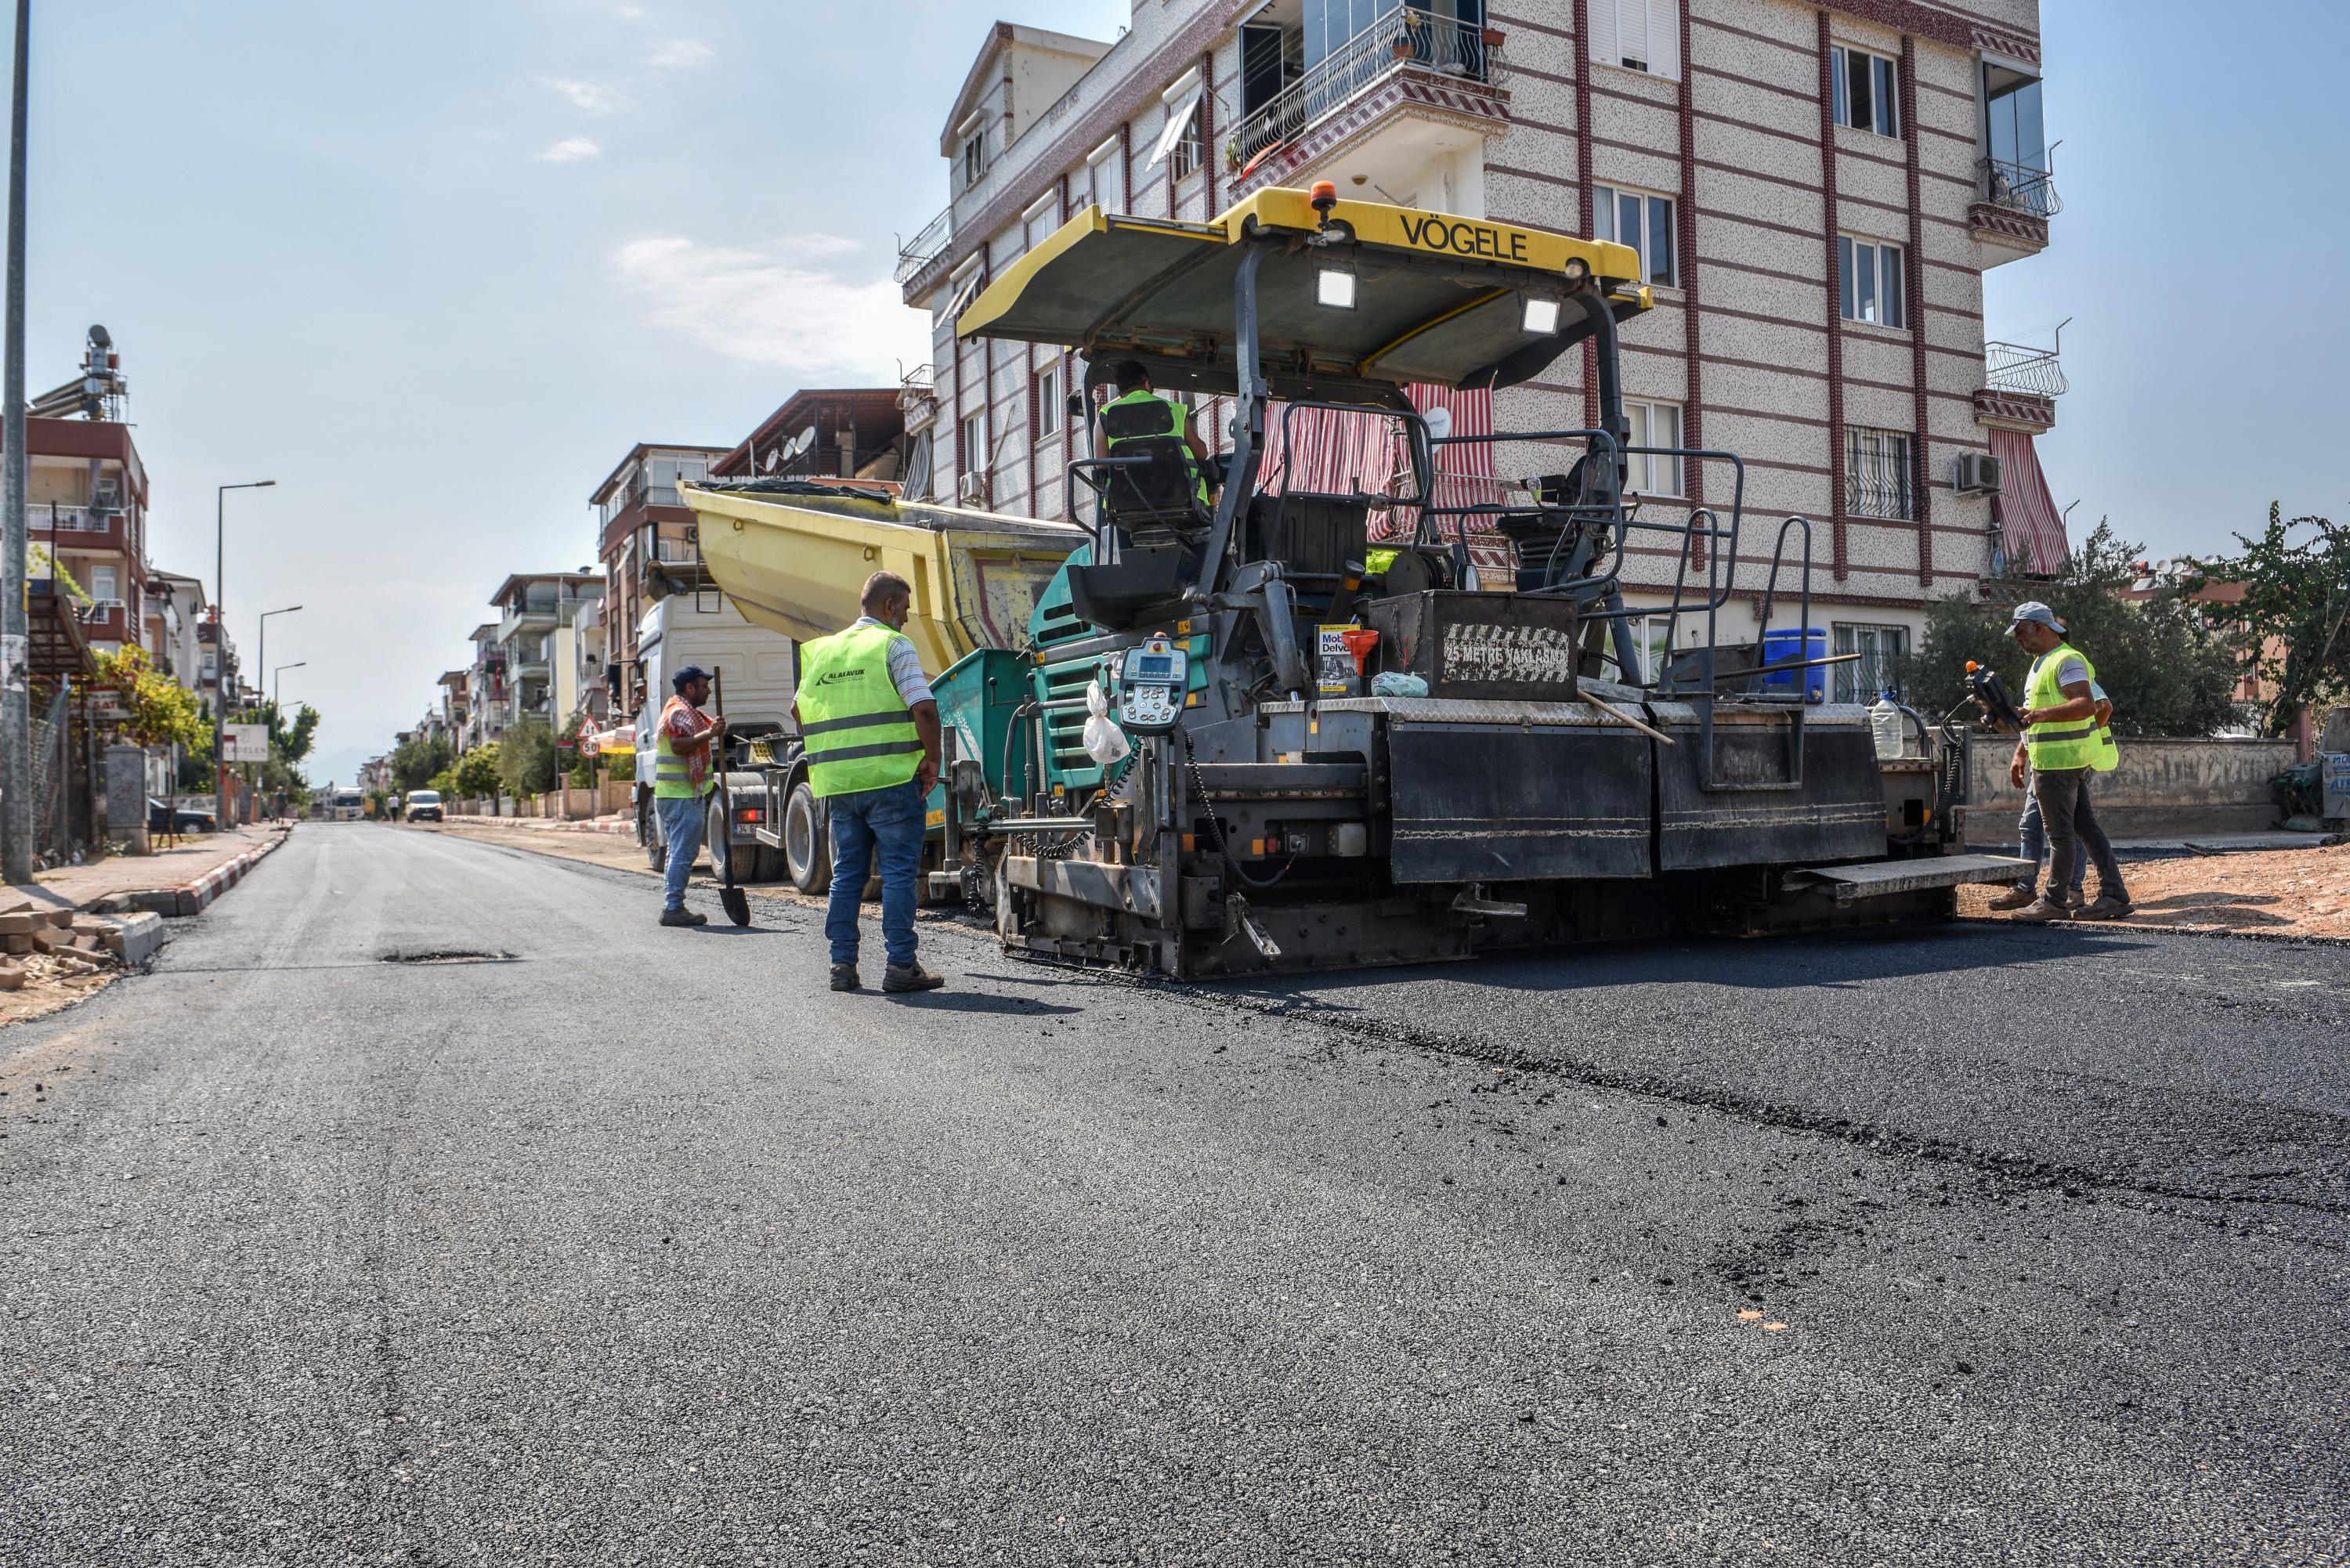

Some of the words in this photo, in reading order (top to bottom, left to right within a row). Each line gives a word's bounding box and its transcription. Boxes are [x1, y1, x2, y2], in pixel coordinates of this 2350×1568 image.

[1400, 214, 1528, 262] VÖGELE
[1462, 646, 1504, 664] METRE
[828, 669, 865, 679] ALAKAVUK
[584, 743, 597, 752] 50
